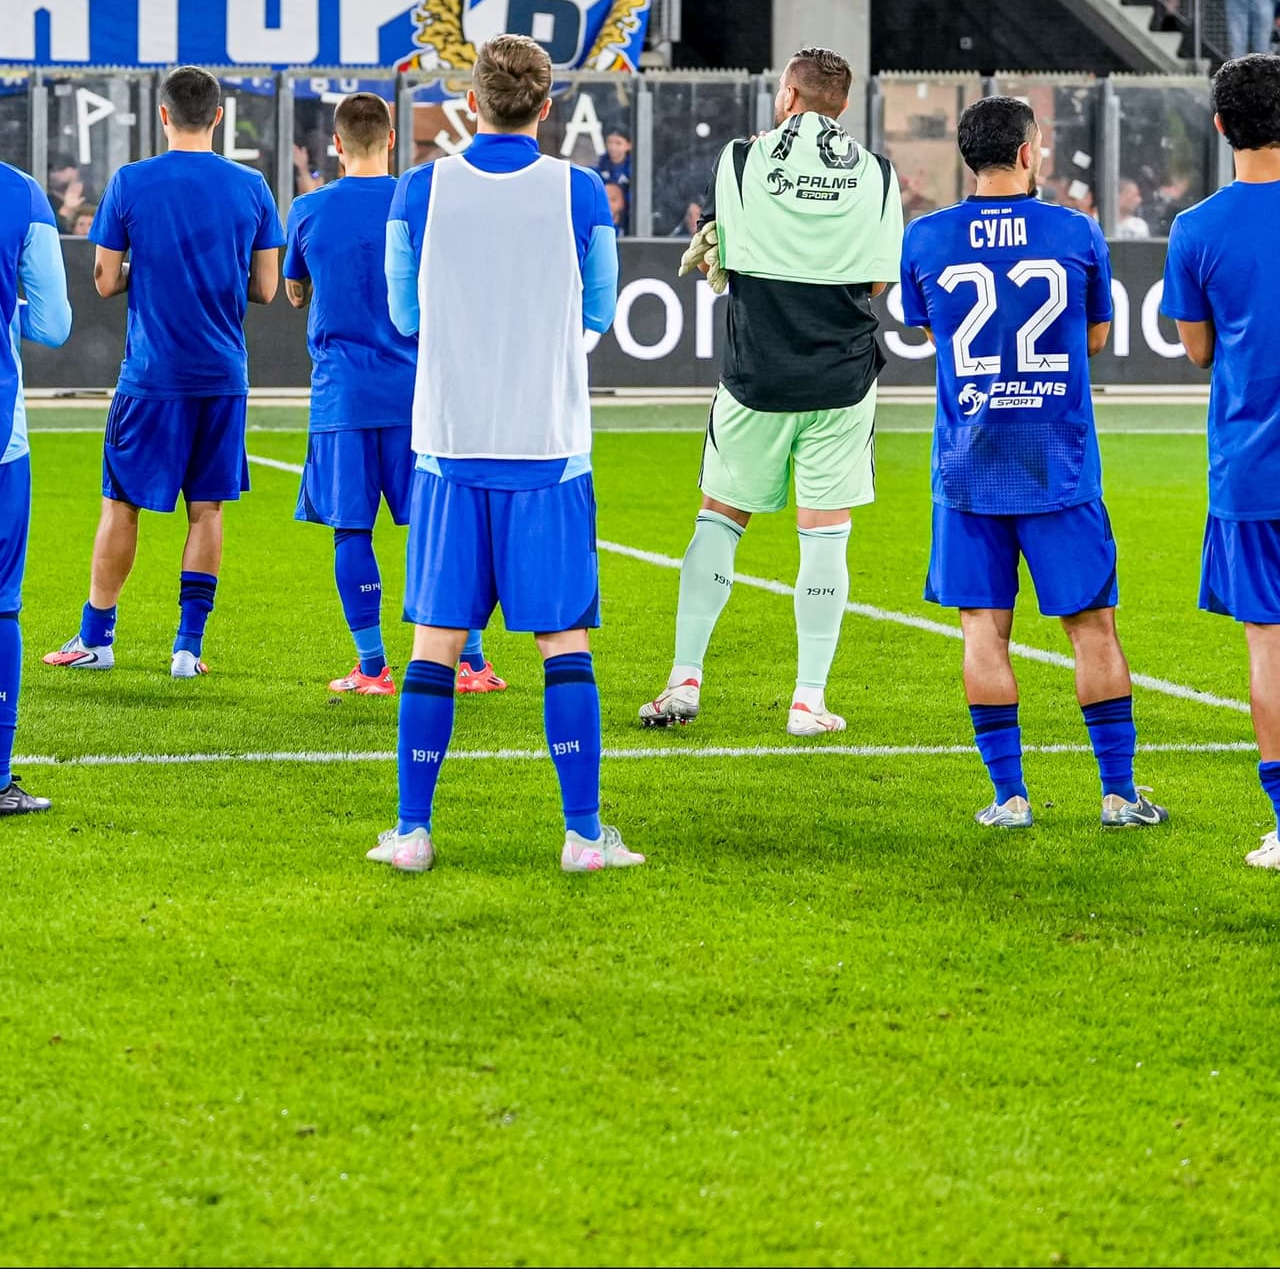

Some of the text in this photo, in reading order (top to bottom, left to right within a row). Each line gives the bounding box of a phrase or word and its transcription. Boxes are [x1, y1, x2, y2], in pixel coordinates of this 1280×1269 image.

[796, 175, 858, 189] PALMS
[800, 191, 835, 200] SPORT
[969, 217, 1028, 249] СУЛА
[936, 258, 1070, 378] 22
[989, 381, 1067, 396] PALMS
[997, 398, 1036, 407] SPORT
[806, 587, 836, 597] 1914
[411, 748, 440, 763] 1914
[552, 740, 581, 756] 1914
